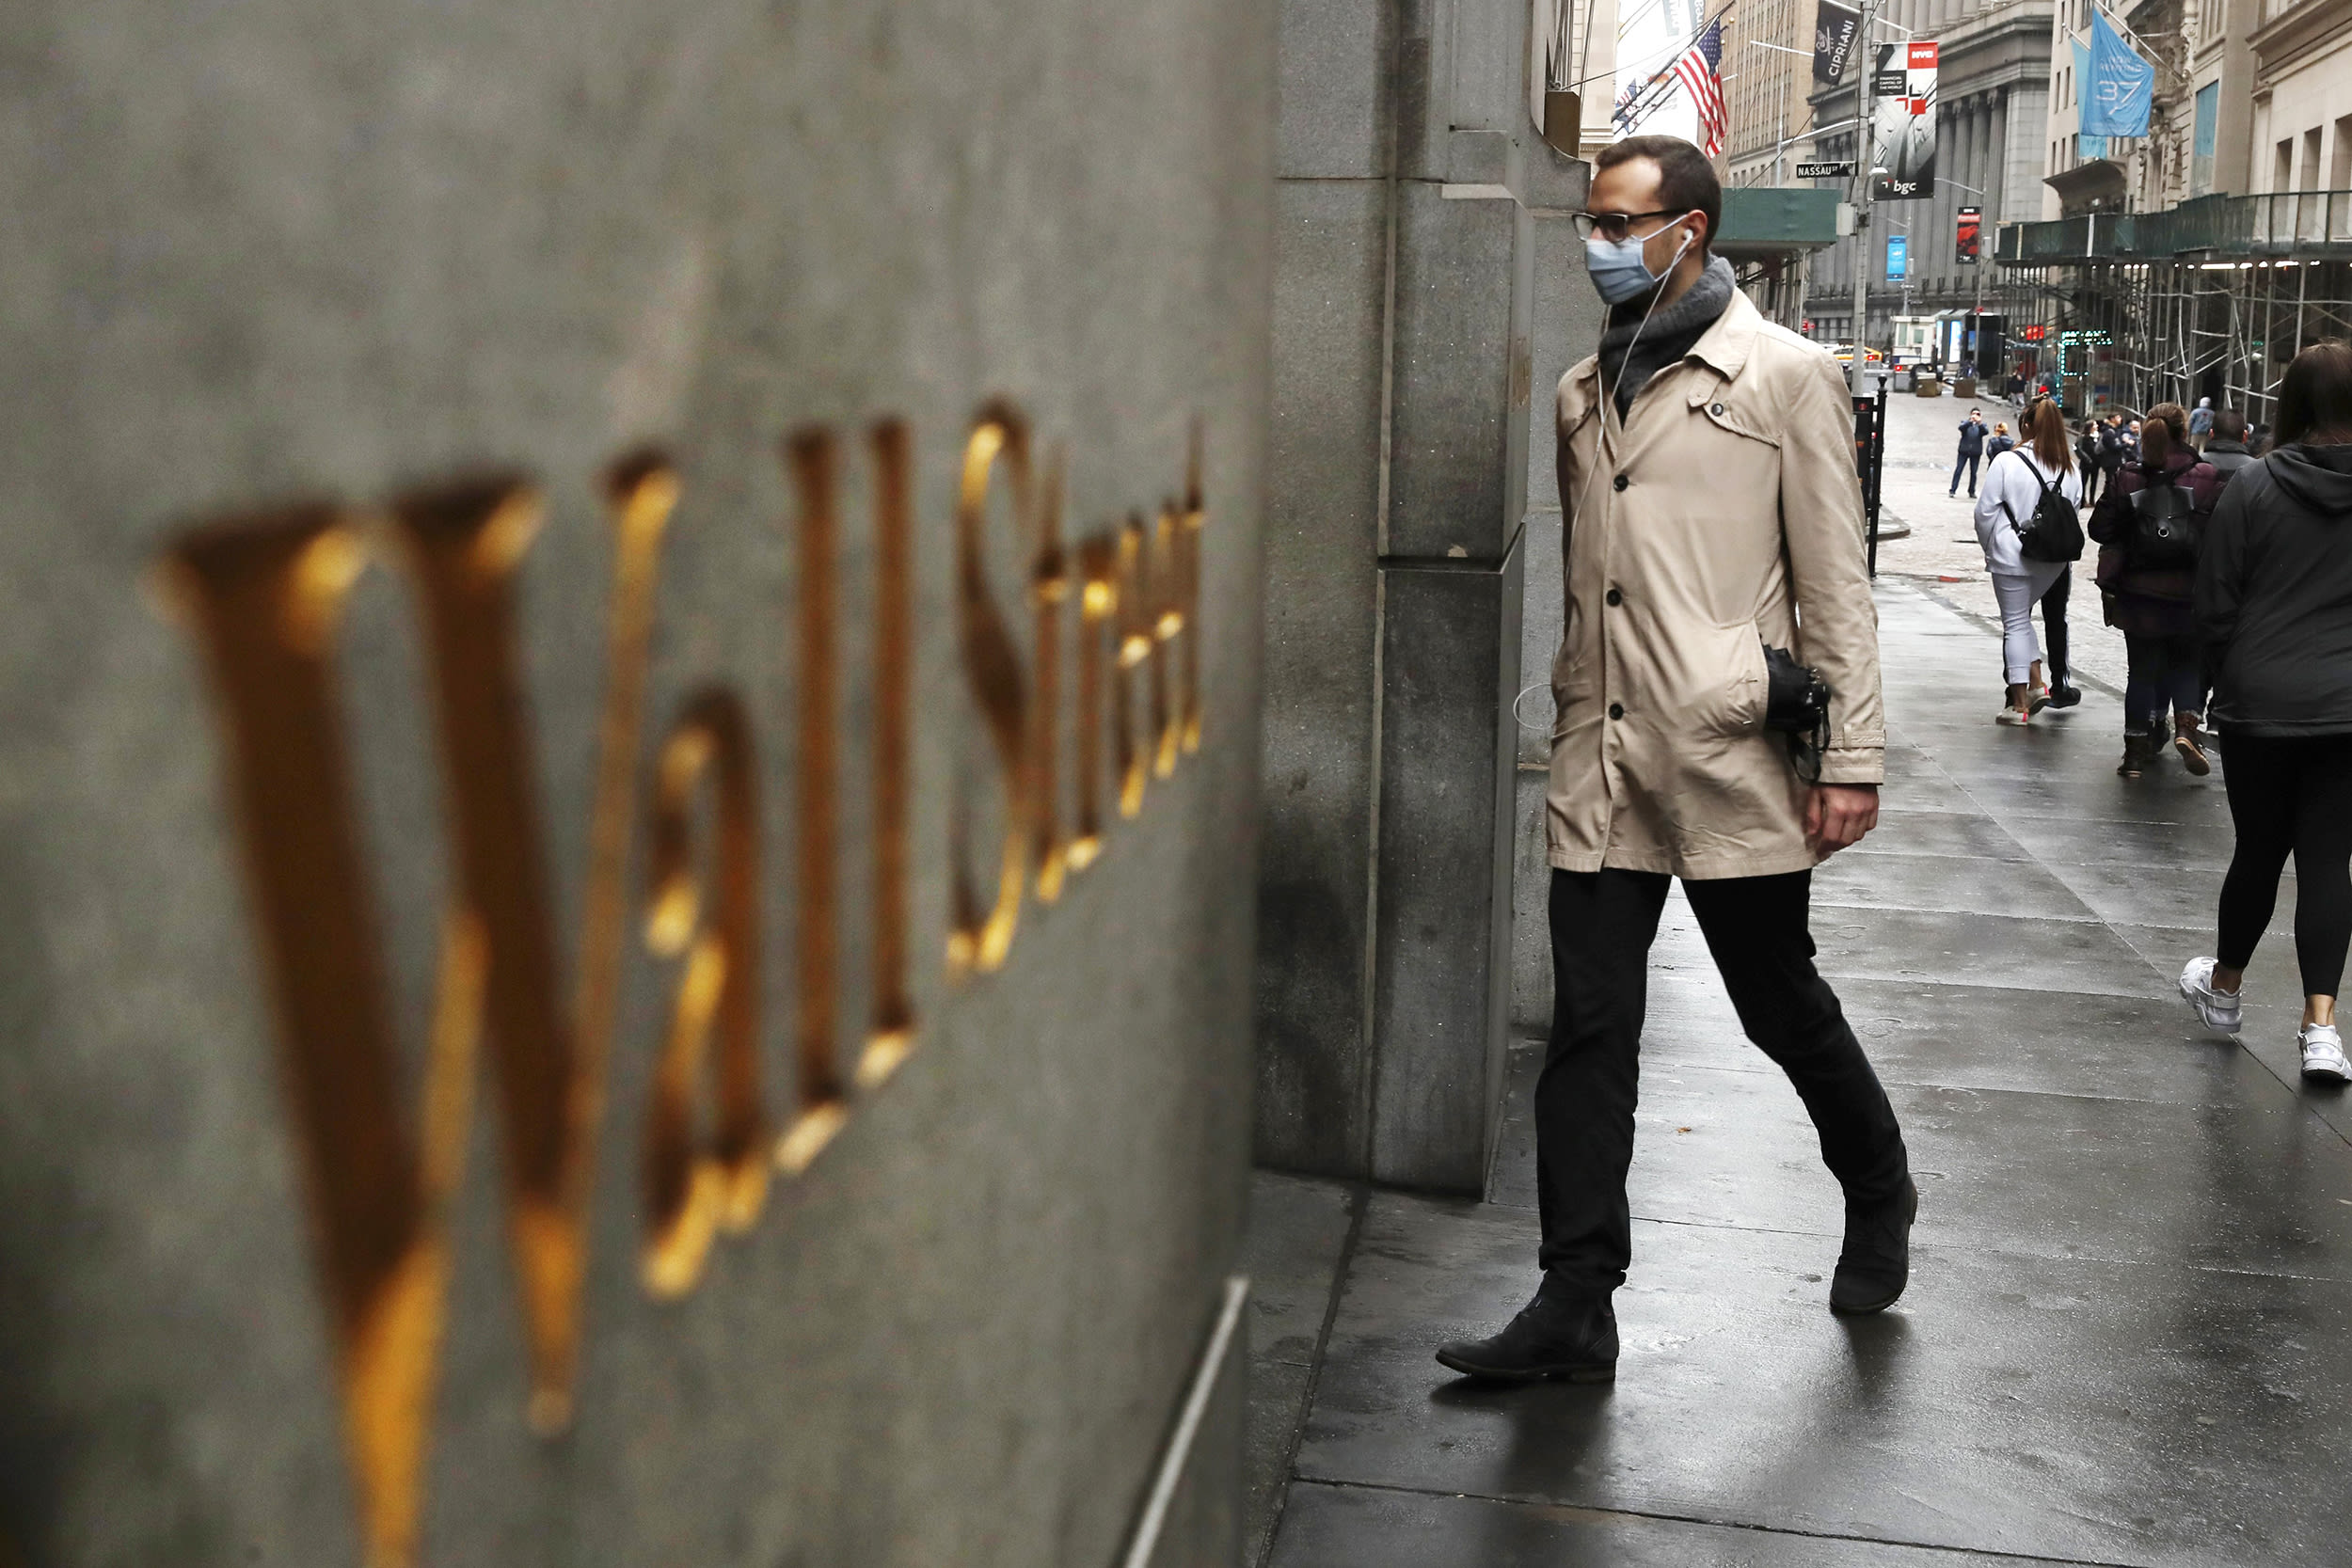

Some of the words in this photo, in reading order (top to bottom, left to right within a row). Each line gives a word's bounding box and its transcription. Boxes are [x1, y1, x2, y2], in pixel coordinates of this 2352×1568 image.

[1828, 20, 1854, 76] CIPRIANI
[2096, 81, 2140, 115] 37
[1798, 166, 1832, 177] NASSAU
[1893, 180, 1916, 195] bgc
[151, 414, 917, 1568] Wall
[944, 395, 1206, 978] Street
